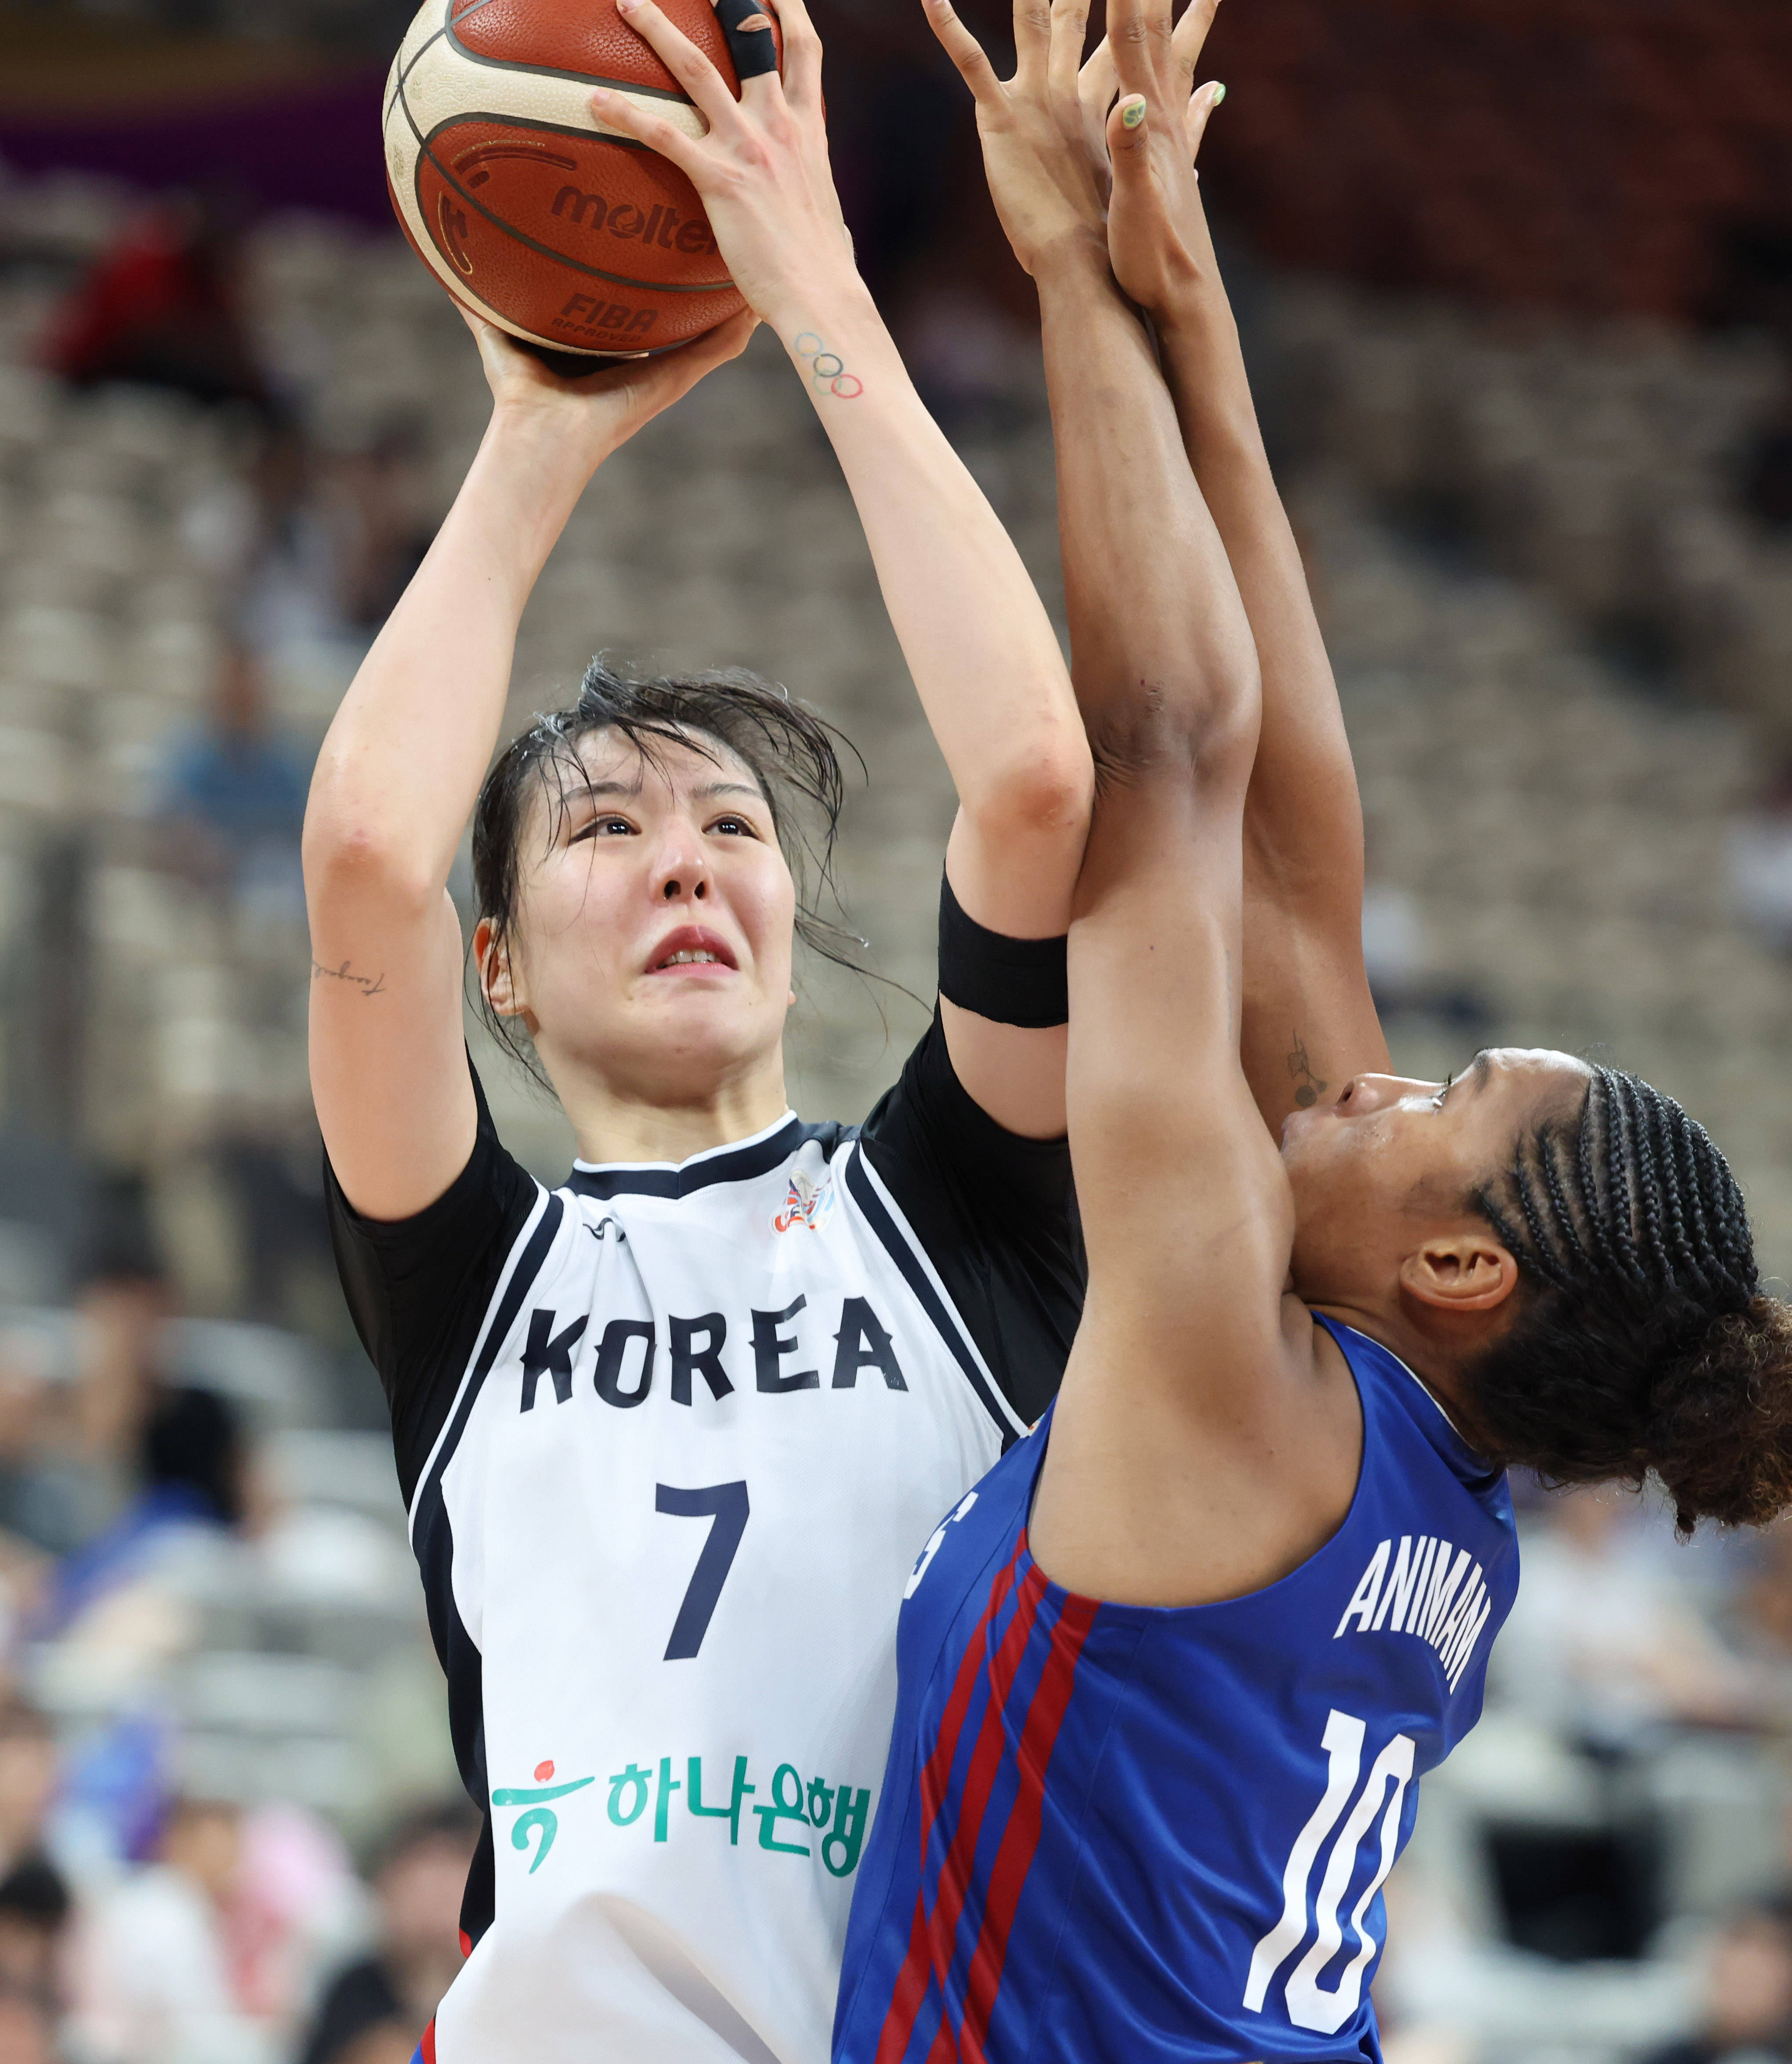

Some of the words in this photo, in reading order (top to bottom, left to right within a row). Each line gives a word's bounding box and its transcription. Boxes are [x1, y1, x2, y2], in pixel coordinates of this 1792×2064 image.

[551, 318, 642, 342] APPROVED
[560, 293, 659, 333] FIBA
[519, 1293, 909, 1413] KOREA
[655, 1479, 750, 1661] 7
[1333, 1535, 1491, 1695] ANIMAM
[607, 1755, 871, 1877] 하나은행
[1242, 1708, 1415, 2035] 10
